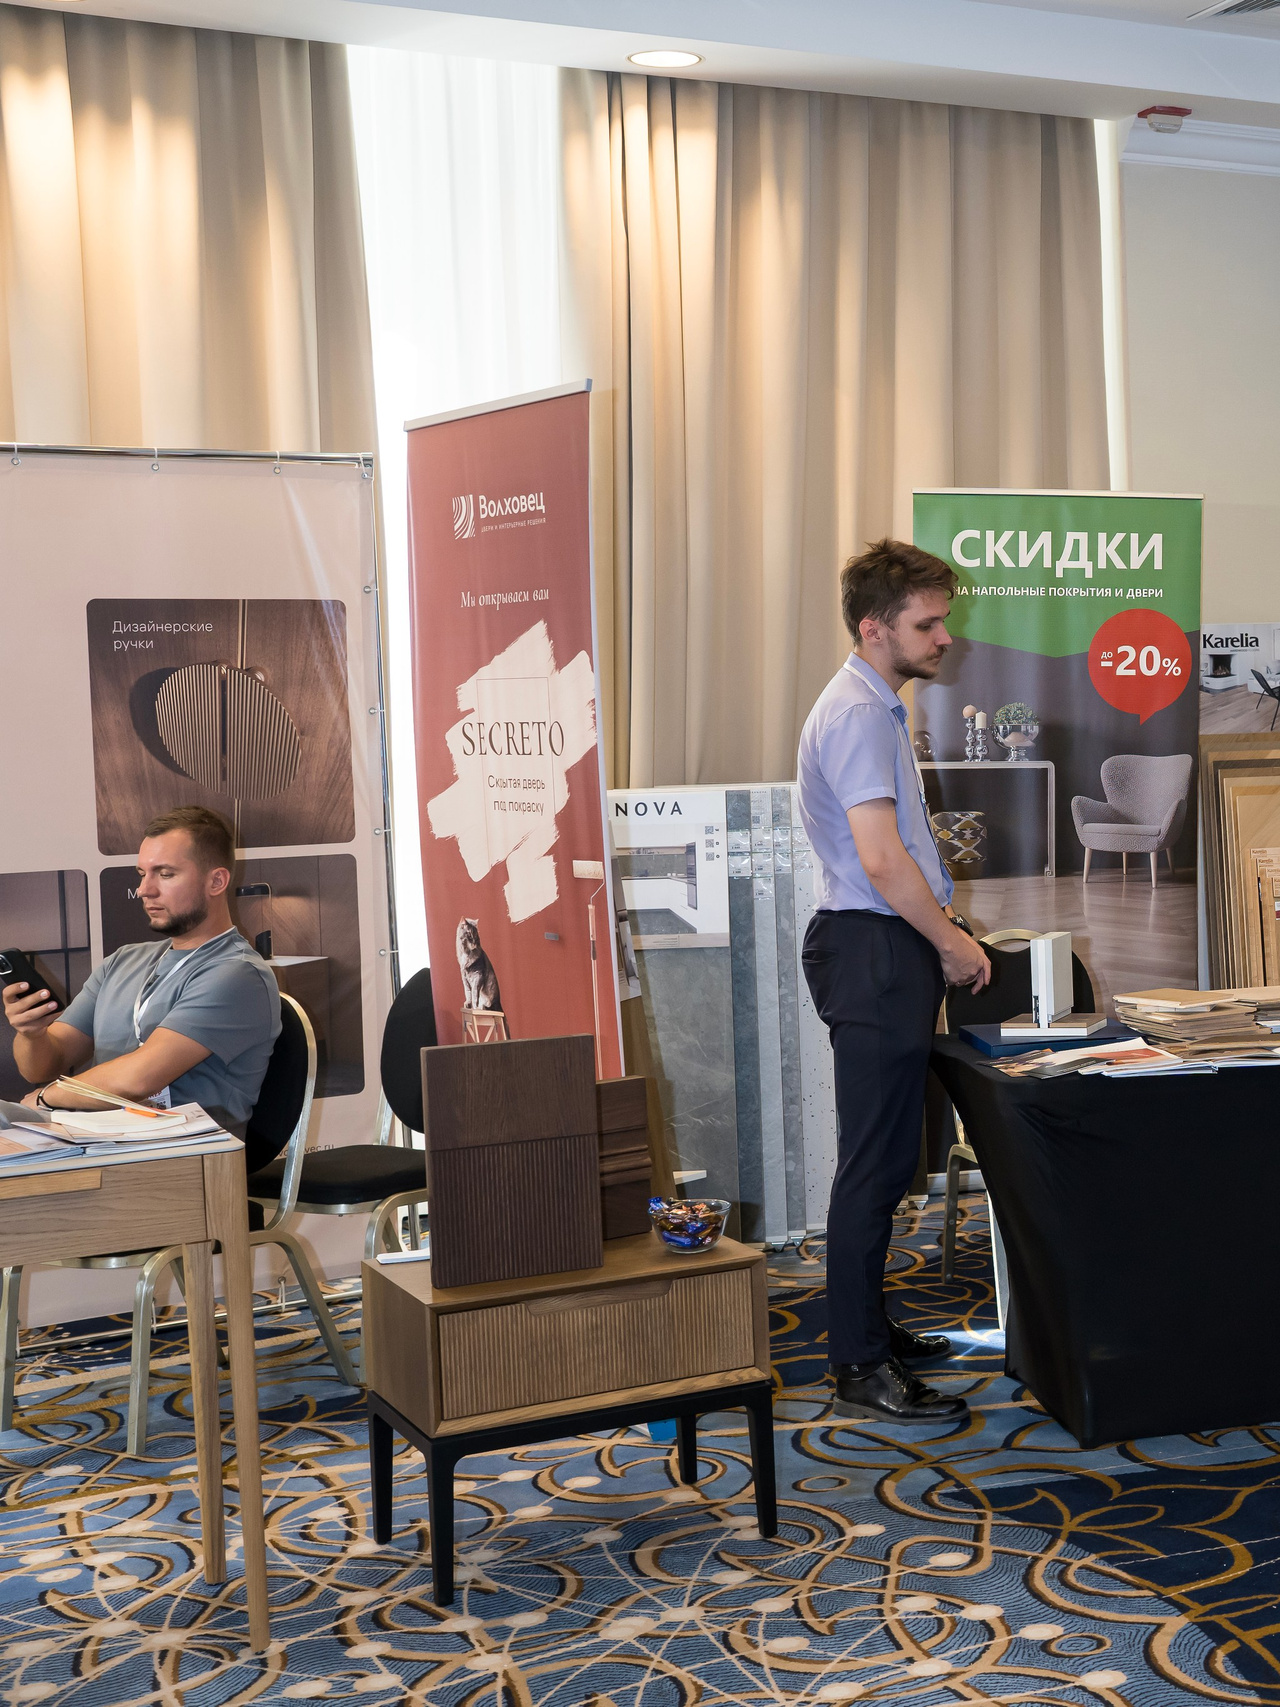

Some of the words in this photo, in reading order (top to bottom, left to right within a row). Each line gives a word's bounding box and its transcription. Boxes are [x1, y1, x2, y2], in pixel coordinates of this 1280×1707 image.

[479, 492, 546, 519] Волховец
[951, 529, 1163, 579] СКИДКИ
[460, 591, 477, 608] Мы
[478, 591, 530, 611] открываем
[532, 588, 549, 602] вам
[972, 586, 1046, 597] НАПОЛЬНЫЕ
[1048, 587, 1112, 597] ПОКРЫТИЯ
[1115, 588, 1124, 597] И
[1126, 588, 1163, 600] ДВЕРИ
[112, 620, 214, 635] Дизайнерские
[113, 639, 154, 652] ручки
[1202, 633, 1260, 649] Karelia
[1101, 645, 1182, 677] -20%
[462, 721, 565, 757] SECRETO
[487, 774, 521, 791] Скрытая
[522, 779, 546, 793] дверь
[508, 801, 544, 816] покраску
